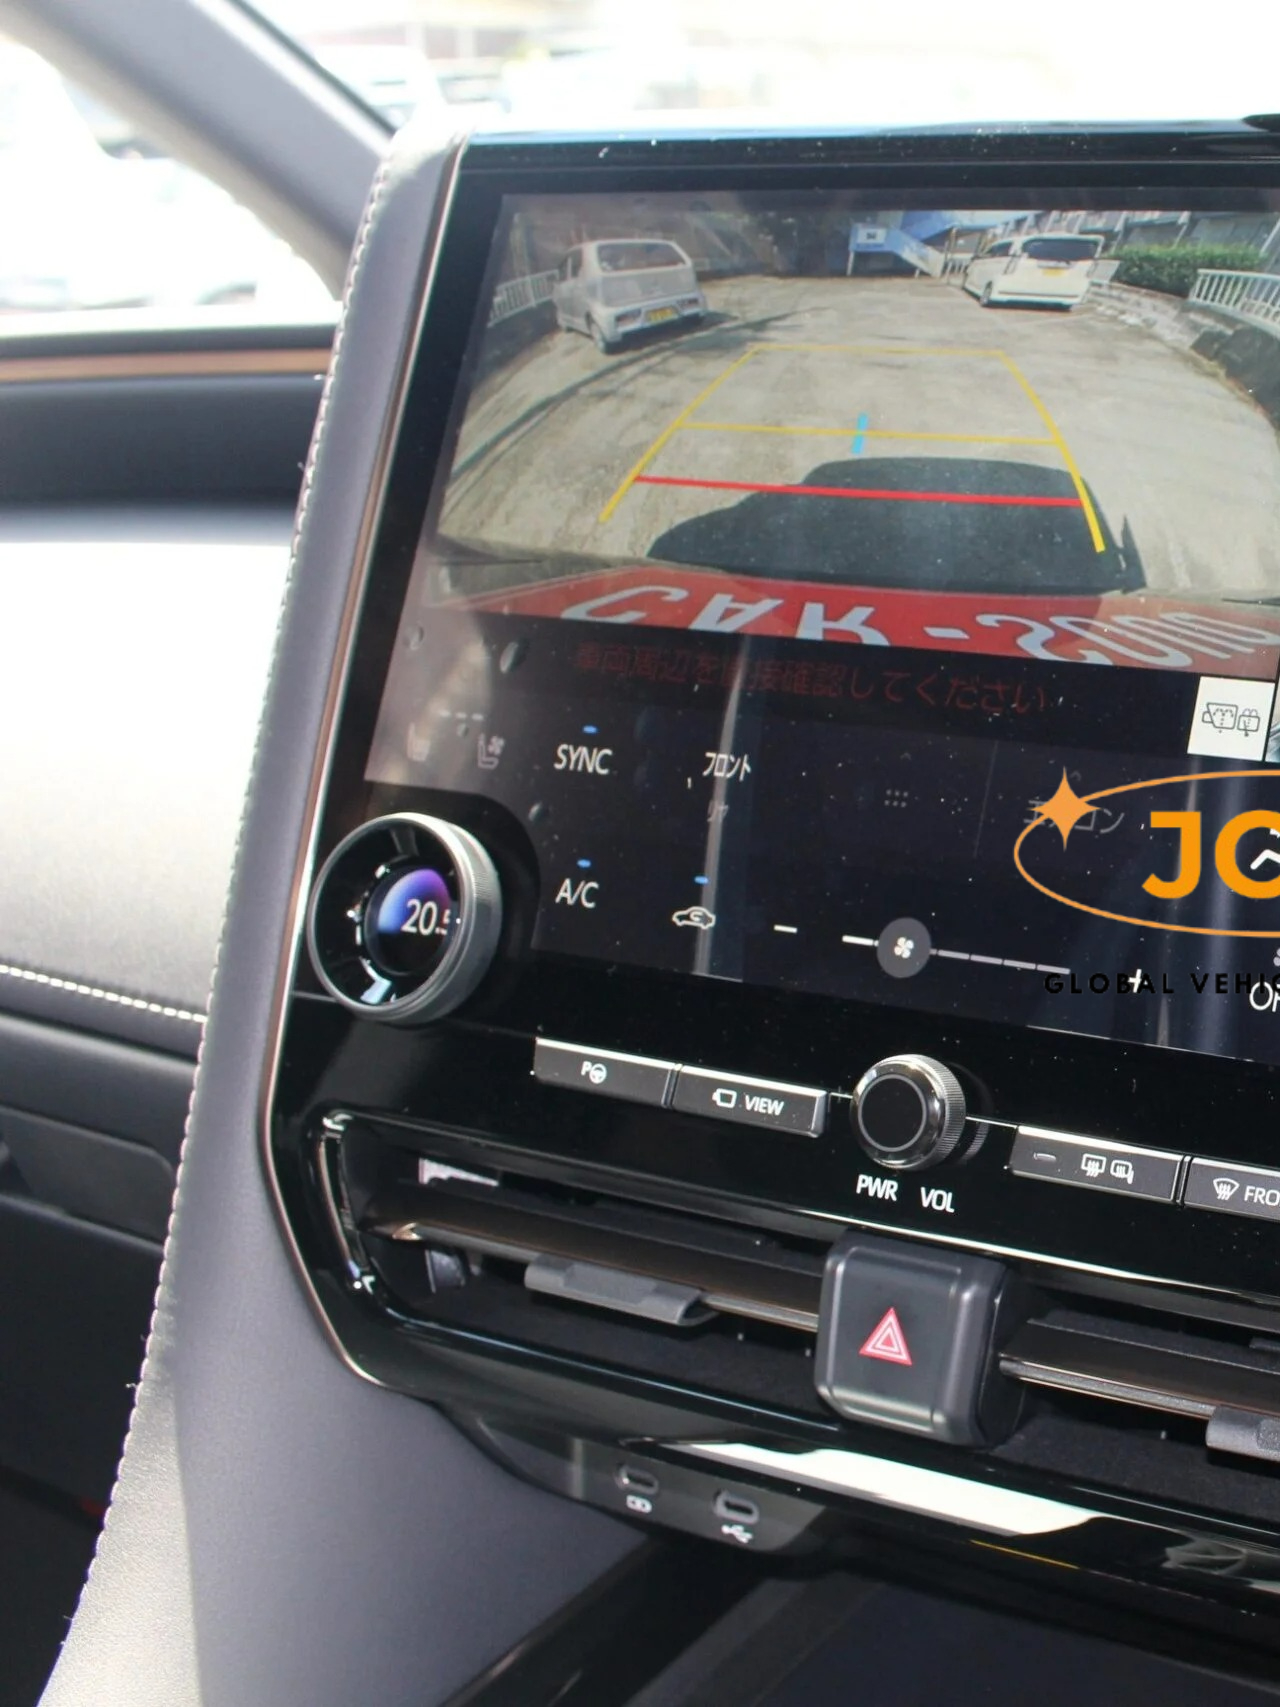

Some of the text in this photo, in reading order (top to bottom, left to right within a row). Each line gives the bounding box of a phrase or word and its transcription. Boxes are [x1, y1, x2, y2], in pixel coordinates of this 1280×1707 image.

[554, 744, 613, 775] SYNC
[702, 752, 751, 781] フロント
[554, 878, 599, 909] A/C
[744, 1094, 784, 1116] VIEW
[856, 1174, 955, 1214] PWR VOL
